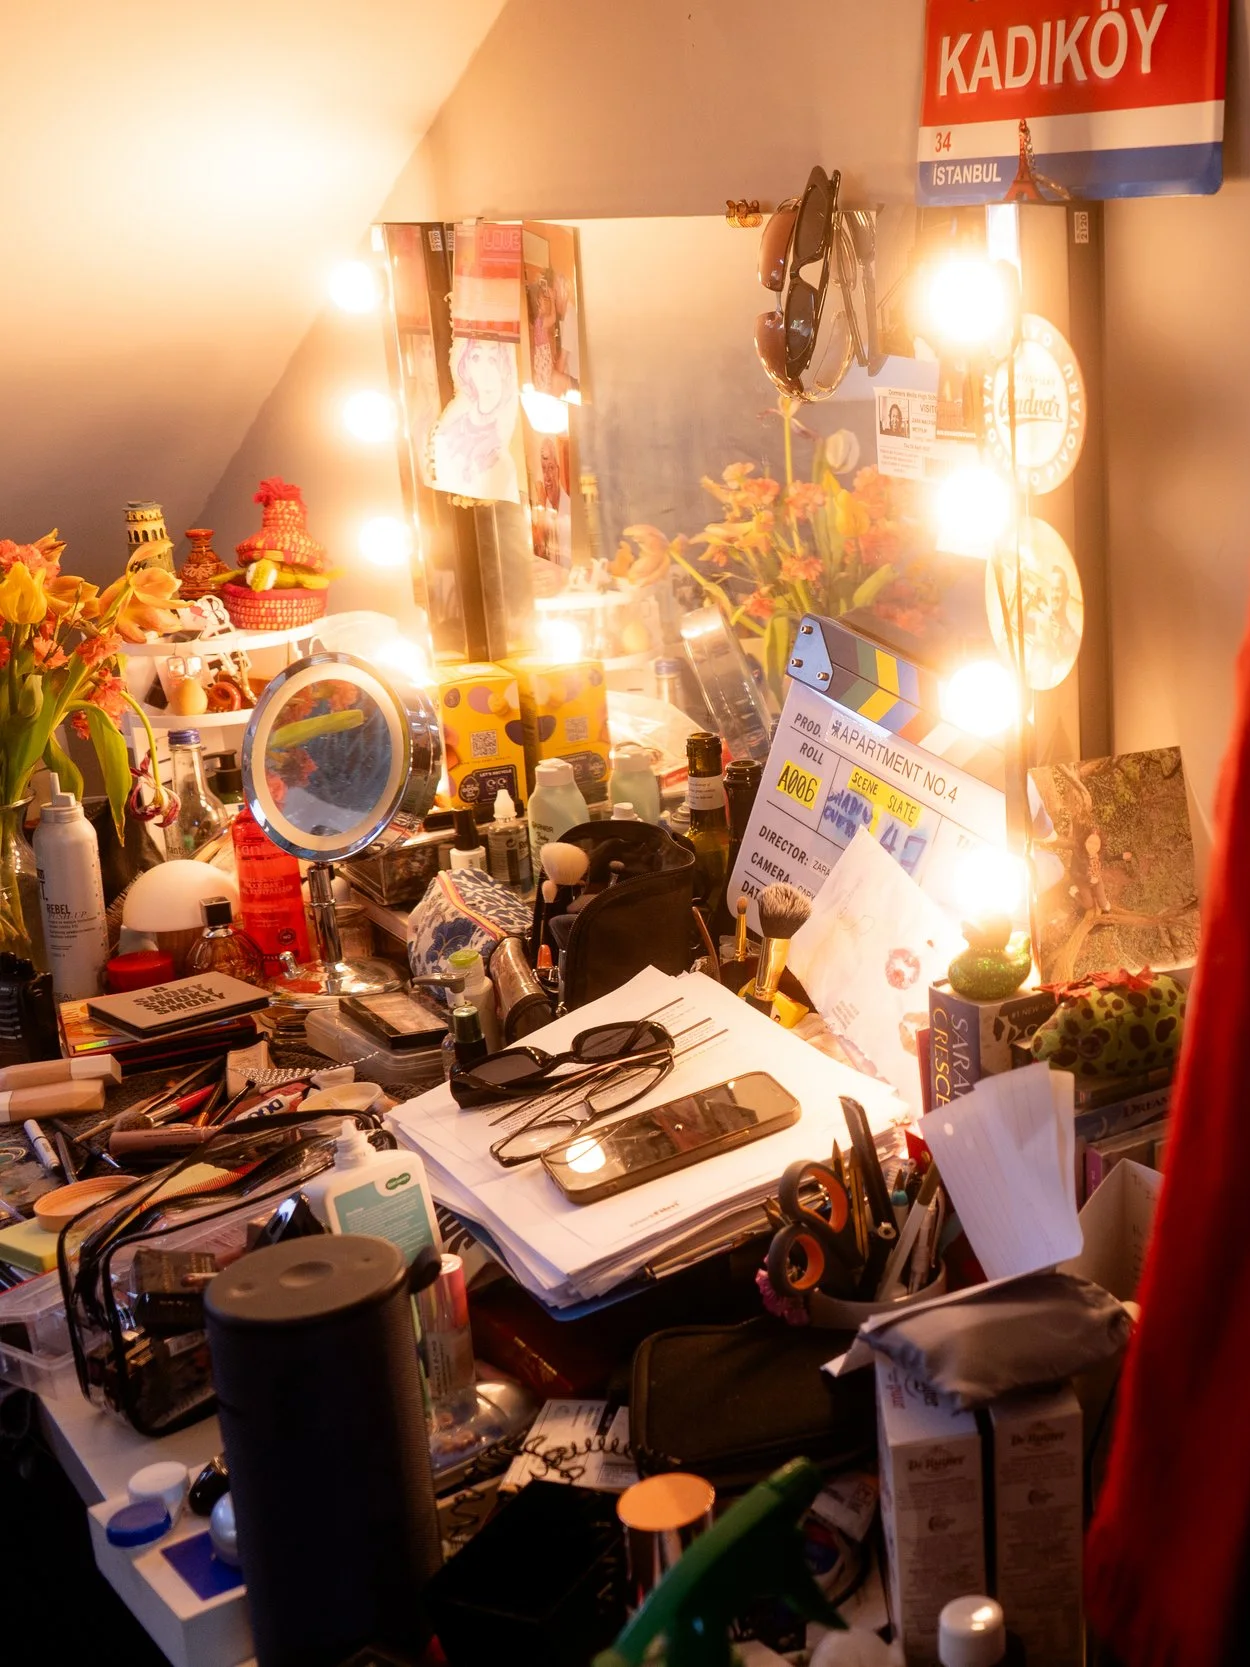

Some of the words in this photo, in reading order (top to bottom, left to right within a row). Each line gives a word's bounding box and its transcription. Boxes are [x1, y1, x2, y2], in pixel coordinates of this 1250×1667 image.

[938, 0, 1169, 97] KADIKÖY
[934, 131, 952, 153] 34
[932, 162, 1002, 187] İSTANBUL
[793, 712, 822, 738] PROD.
[839, 725, 923, 783] APARTMENT
[923, 770, 959, 804] NO.4
[799, 741, 824, 766] ROLL
[851, 771, 879, 797] SCENE
[887, 794, 918, 823] SLATE
[758, 824, 809, 866] DIRECTOR:
[740, 880, 761, 901] DAT
[46, 903, 71, 915] REBEL
[133, 983, 204, 1006] SMOKY
[143, 988, 216, 1010] SMOKY
[154, 992, 226, 1015] SMOKY
